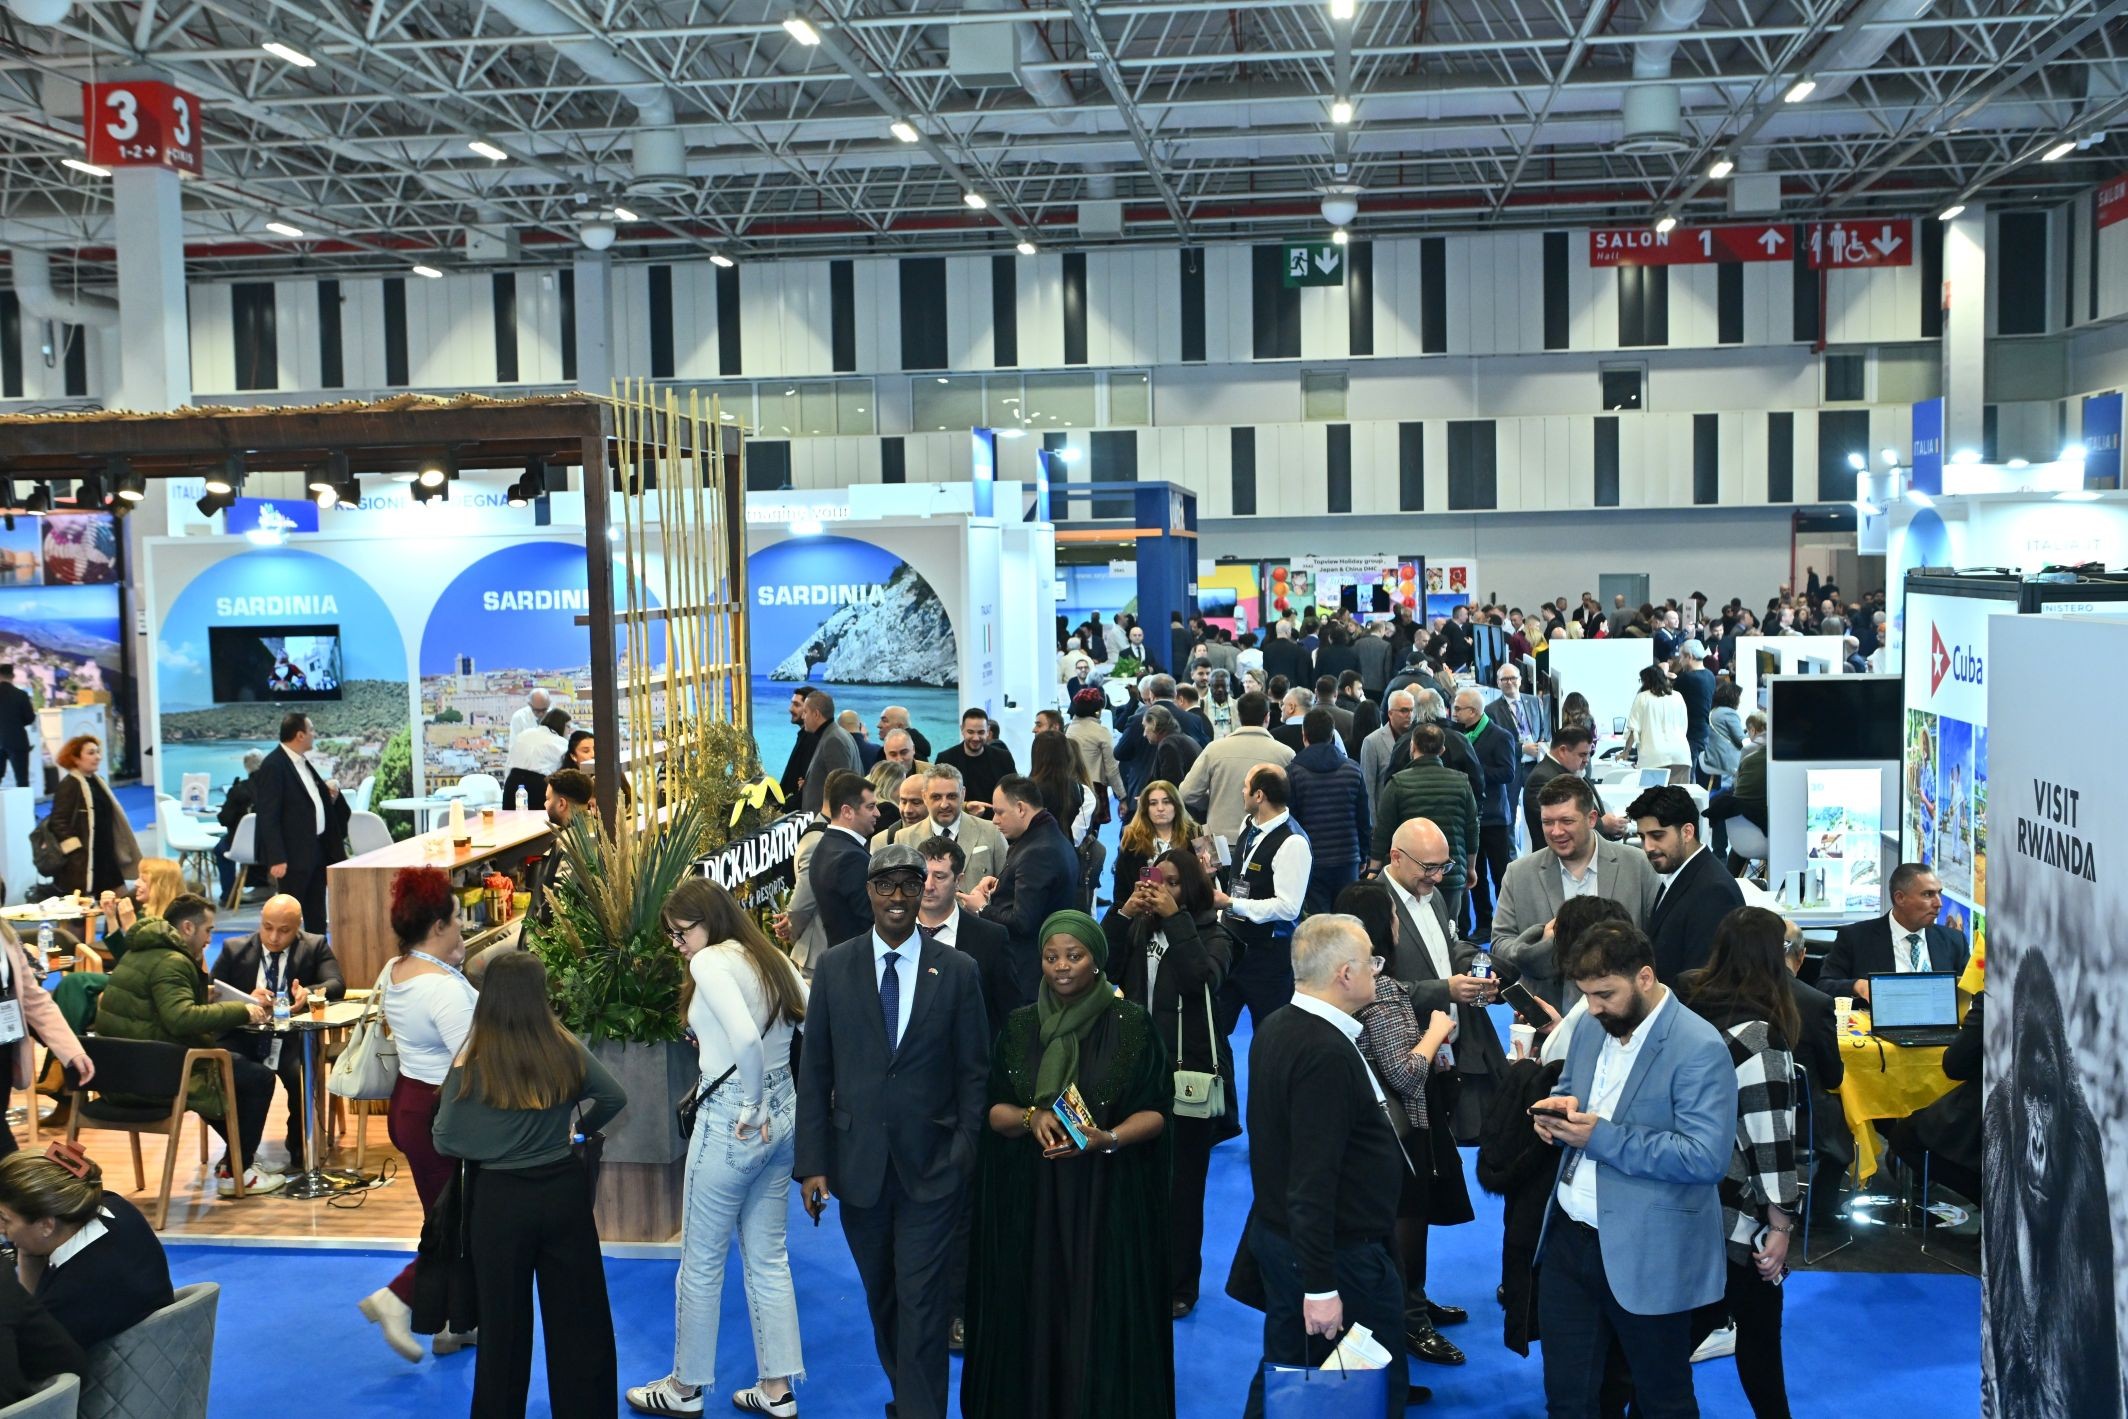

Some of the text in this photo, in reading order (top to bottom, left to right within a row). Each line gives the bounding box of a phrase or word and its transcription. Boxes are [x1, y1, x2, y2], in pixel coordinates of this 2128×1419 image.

[106, 89, 139, 141] 3
[173, 96, 191, 147] 3
[119, 144, 143, 159] 1-2
[1596, 229, 1712, 257] SALON 1
[1597, 251, 1620, 260] Hall
[1914, 438, 1934, 456] ITALIA
[216, 594, 338, 616] SARDINIA
[483, 589, 589, 611] SARDINI
[758, 584, 886, 606] SARDINIA
[1952, 645, 1983, 685] Cuba
[2033, 778, 2079, 829] VISIT
[2018, 816, 2096, 883] RWANDA
[756, 876, 785, 905] RESORTS
